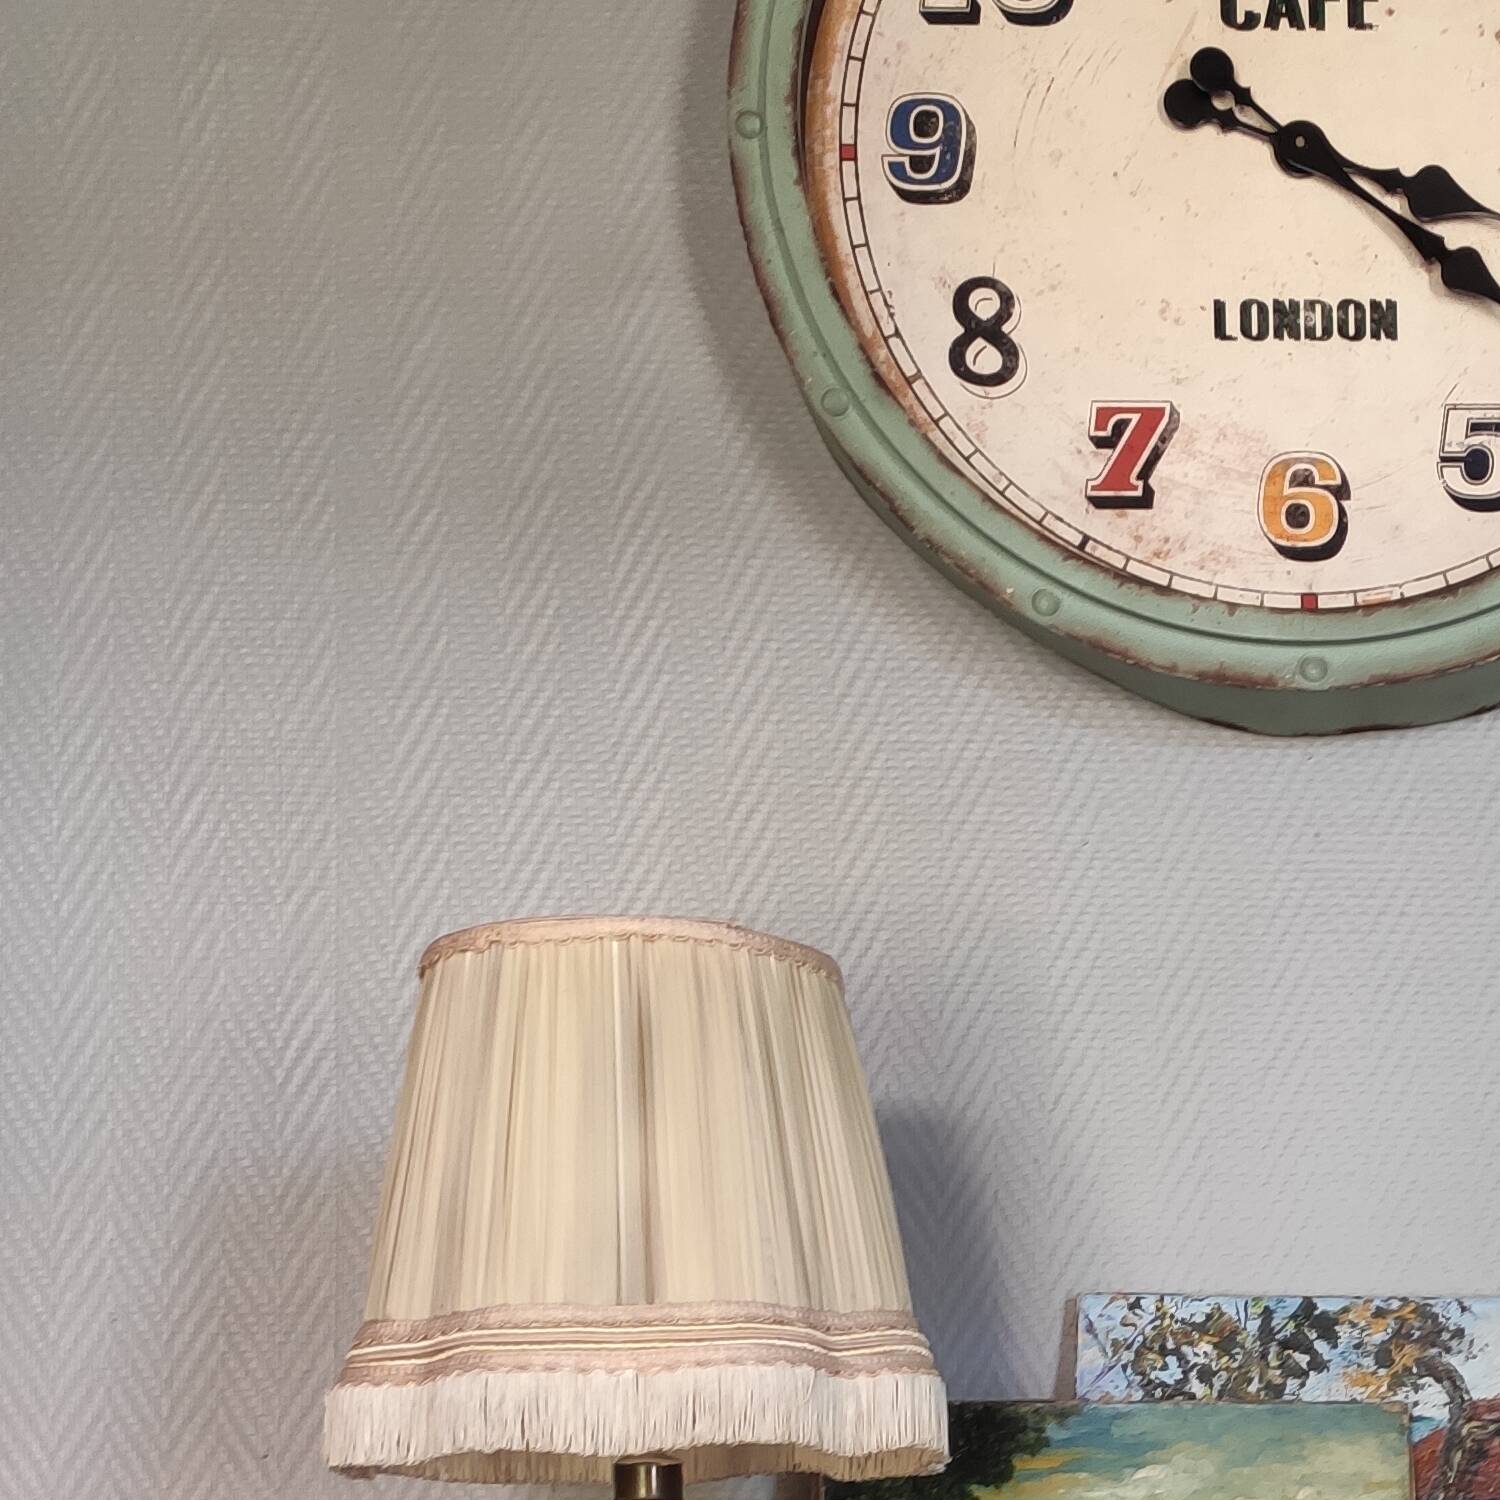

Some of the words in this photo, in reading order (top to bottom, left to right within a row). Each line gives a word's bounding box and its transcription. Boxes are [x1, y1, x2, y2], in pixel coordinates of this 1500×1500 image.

[881, 92, 977, 204] 9
[948, 276, 1028, 399] 8
[1213, 298, 1399, 342] LONDON
[1085, 400, 1180, 509] 7
[1257, 450, 1351, 561] 6
